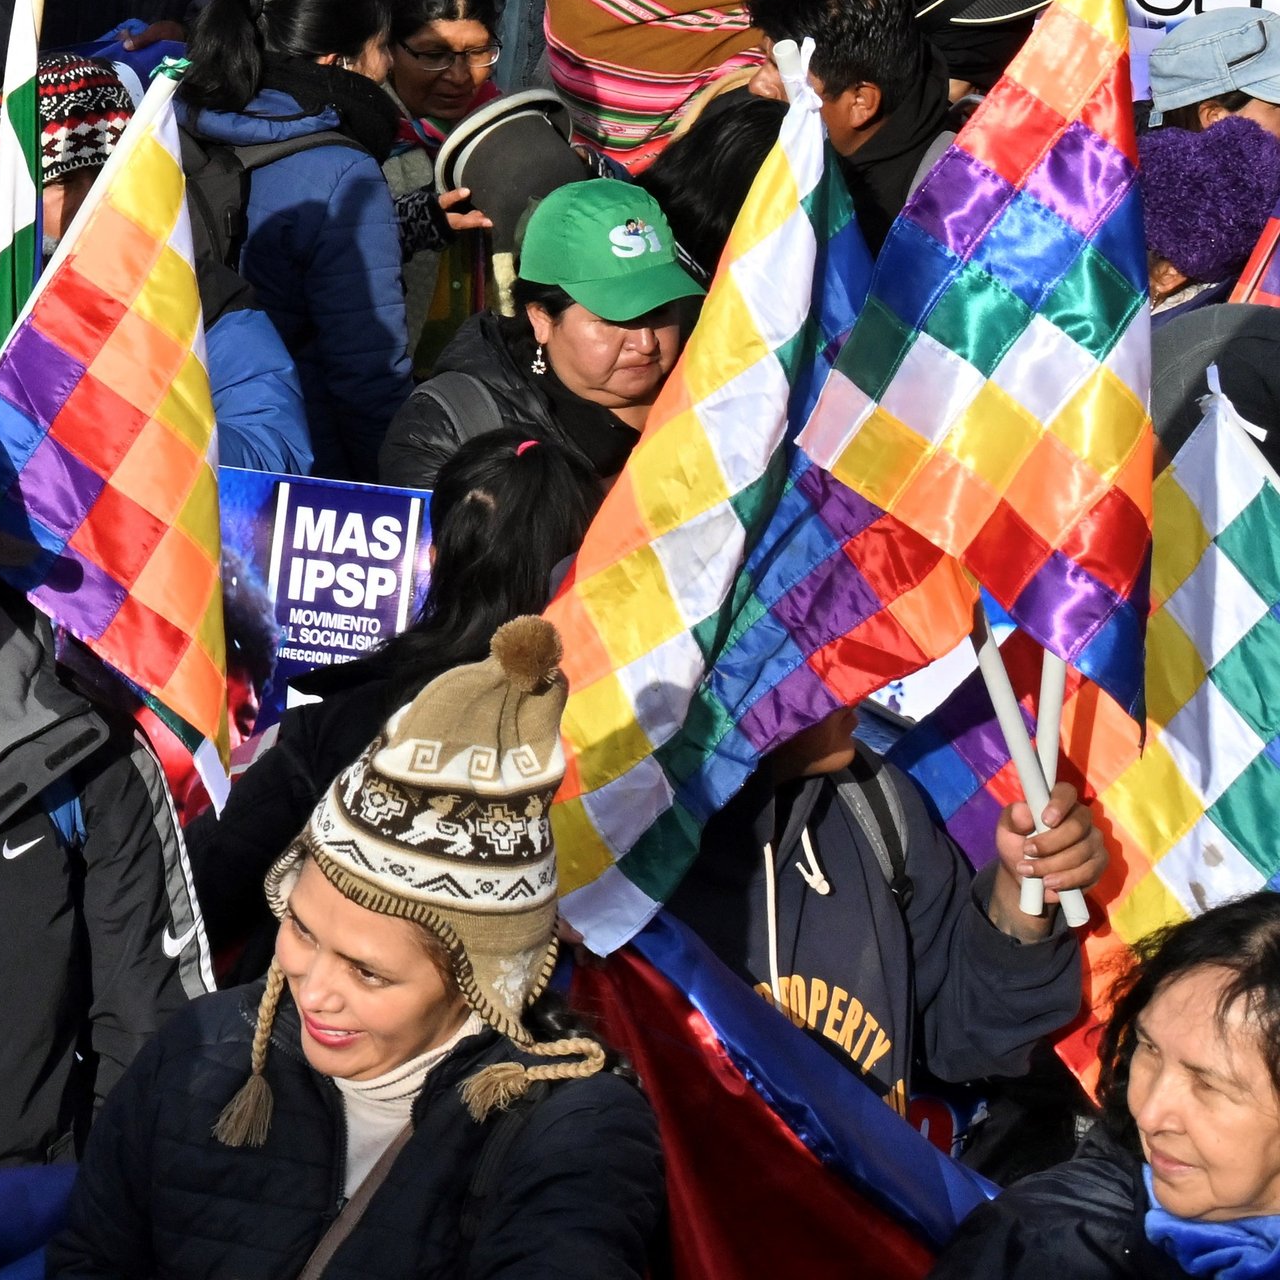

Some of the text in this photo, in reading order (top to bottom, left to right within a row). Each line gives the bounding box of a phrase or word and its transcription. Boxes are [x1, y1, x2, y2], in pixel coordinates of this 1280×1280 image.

[292, 506, 403, 561] MAS
[287, 556, 397, 611] IPSP
[289, 607, 381, 635] MOVIMIENTO
